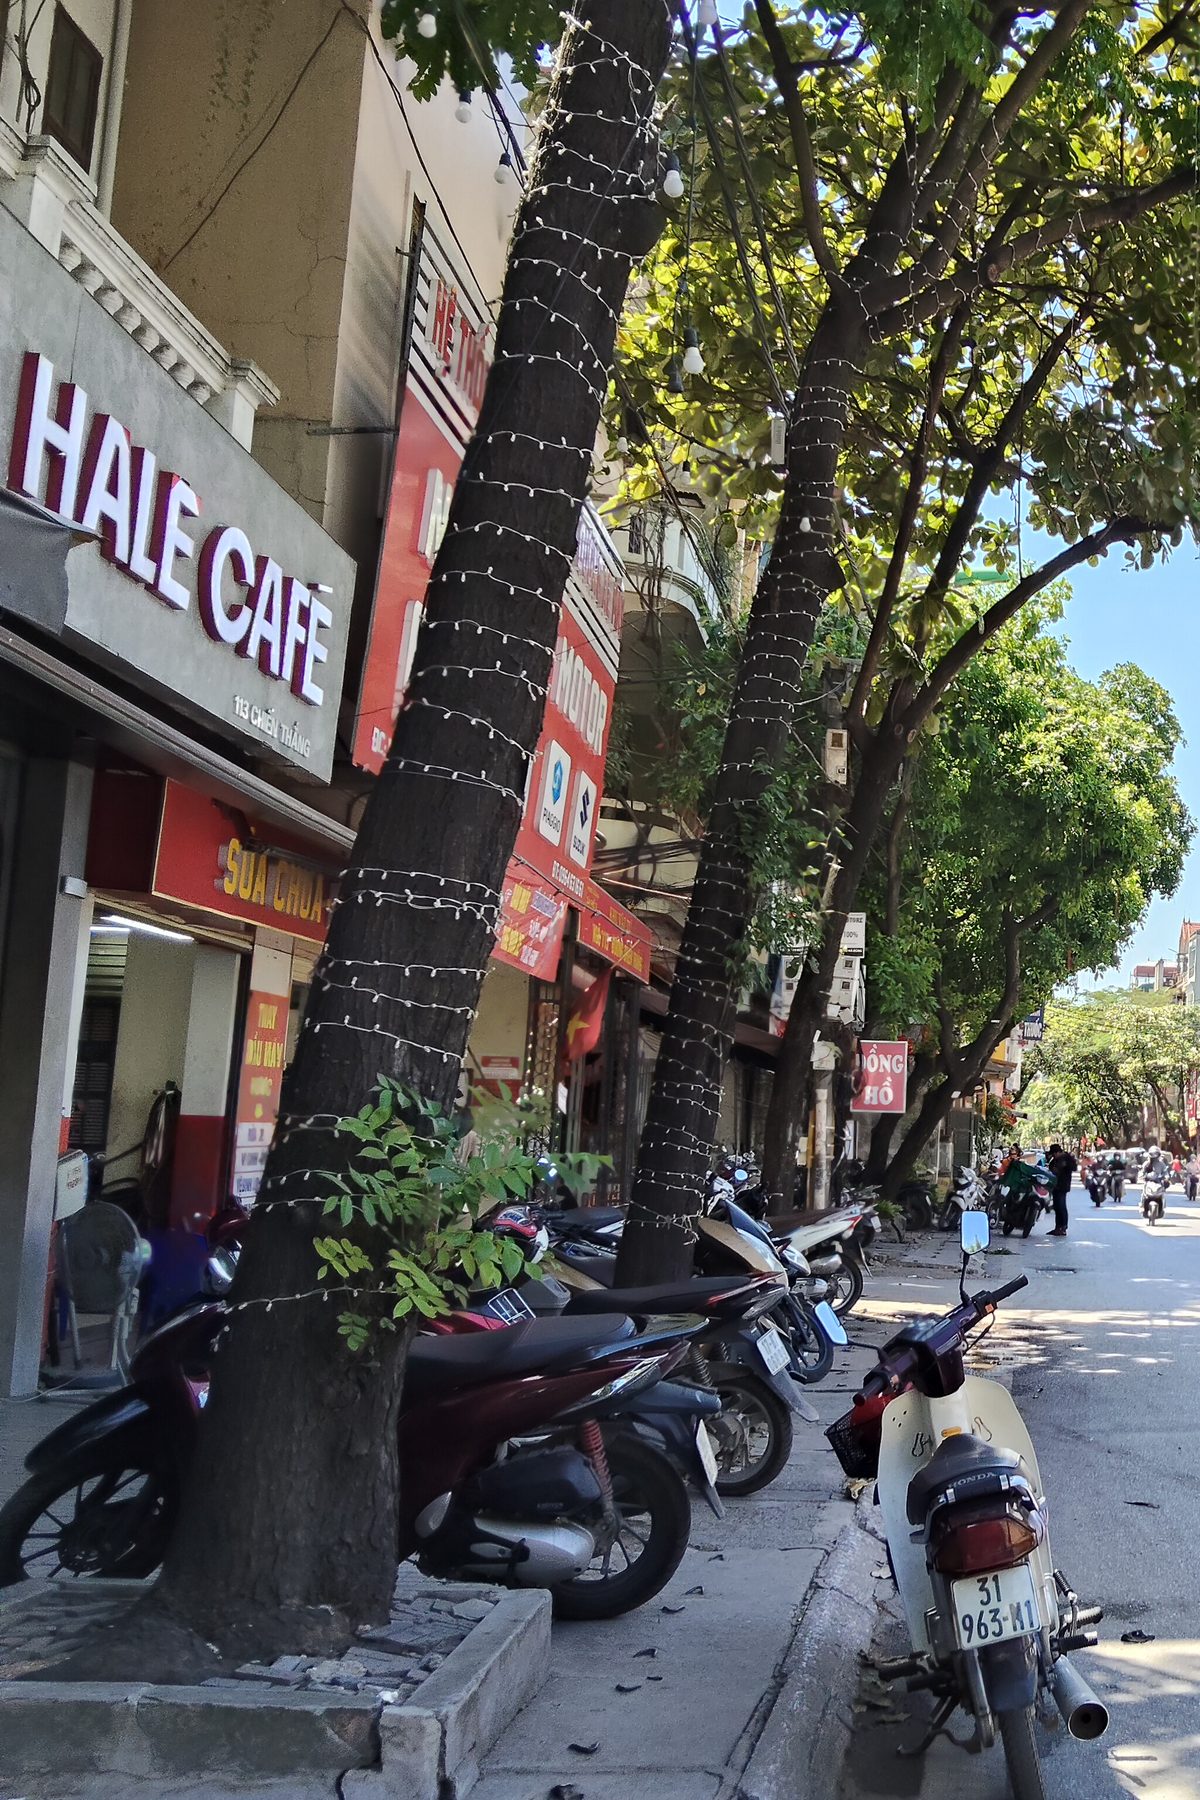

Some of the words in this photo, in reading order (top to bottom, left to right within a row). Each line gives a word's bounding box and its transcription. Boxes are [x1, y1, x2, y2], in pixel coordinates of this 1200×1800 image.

[8, 352, 203, 611] HALE
[234, 695, 249, 720] 113
[550, 636, 608, 756] MOTOR
[543, 807, 561, 834] PIAGGIO
[863, 1077, 894, 1106] HỒ
[948, 1471, 998, 1489] HONDA
[977, 1574, 1002, 1606] 31
